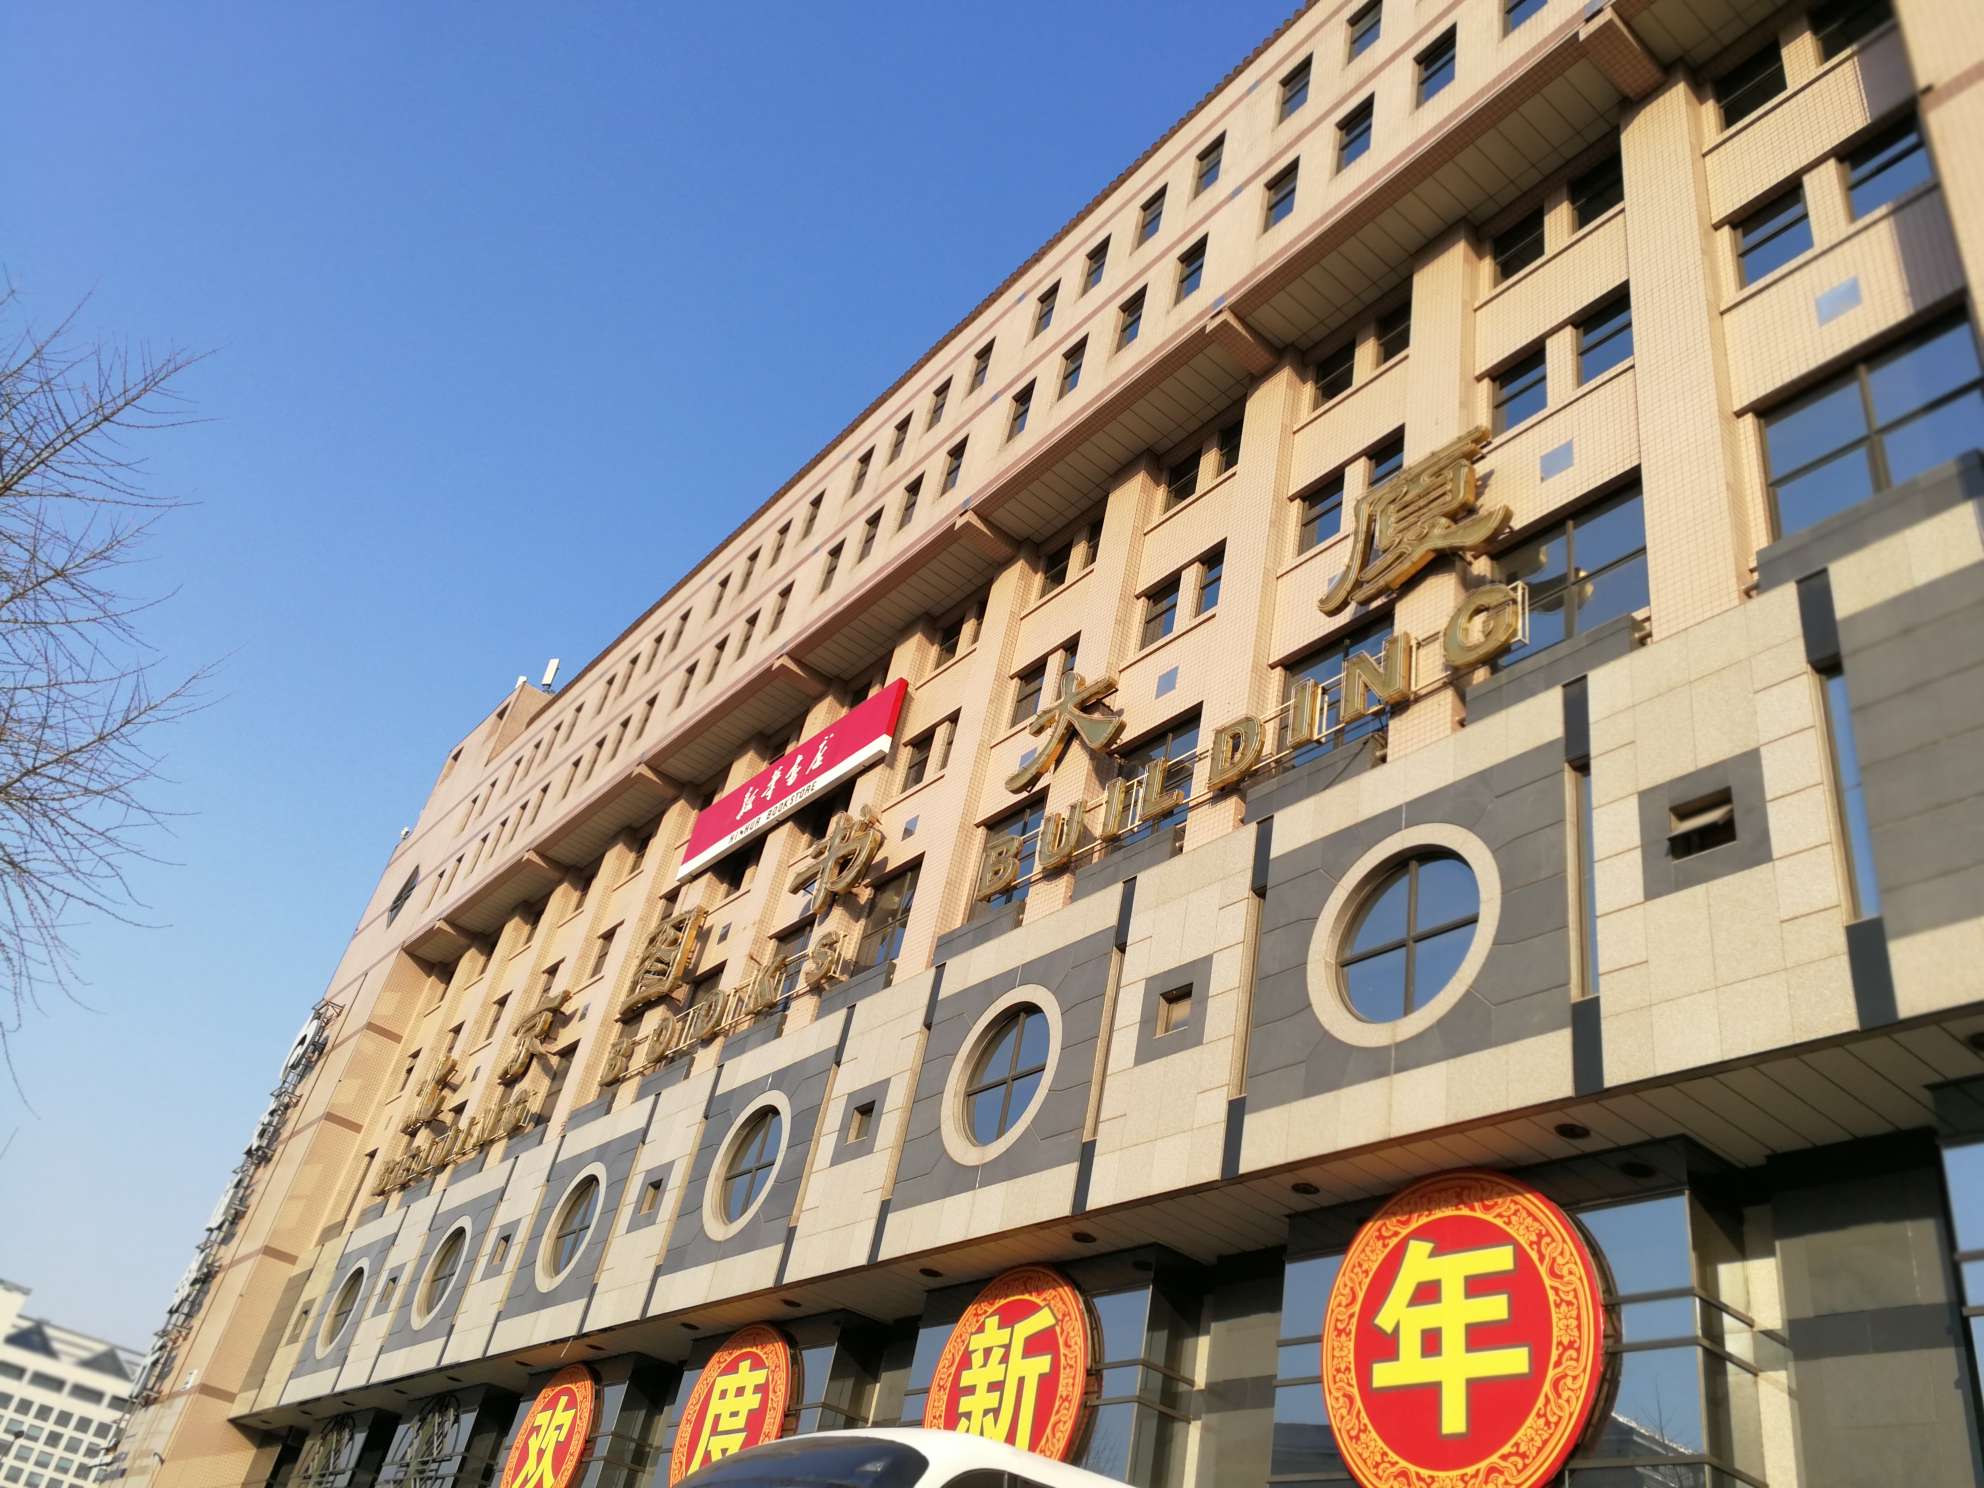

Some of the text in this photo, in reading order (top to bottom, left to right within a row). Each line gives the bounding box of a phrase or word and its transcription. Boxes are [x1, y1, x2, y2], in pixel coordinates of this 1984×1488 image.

[599, 930, 841, 1087] BOOKS
[978, 583, 1519, 901] BUILDING
[766, 780, 817, 819] BOOKSTORE
[956, 1305, 1057, 1450] 新
[1371, 1239, 1531, 1436] 年
[511, 1395, 577, 1488] 欢
[686, 1359, 768, 1477] 度
